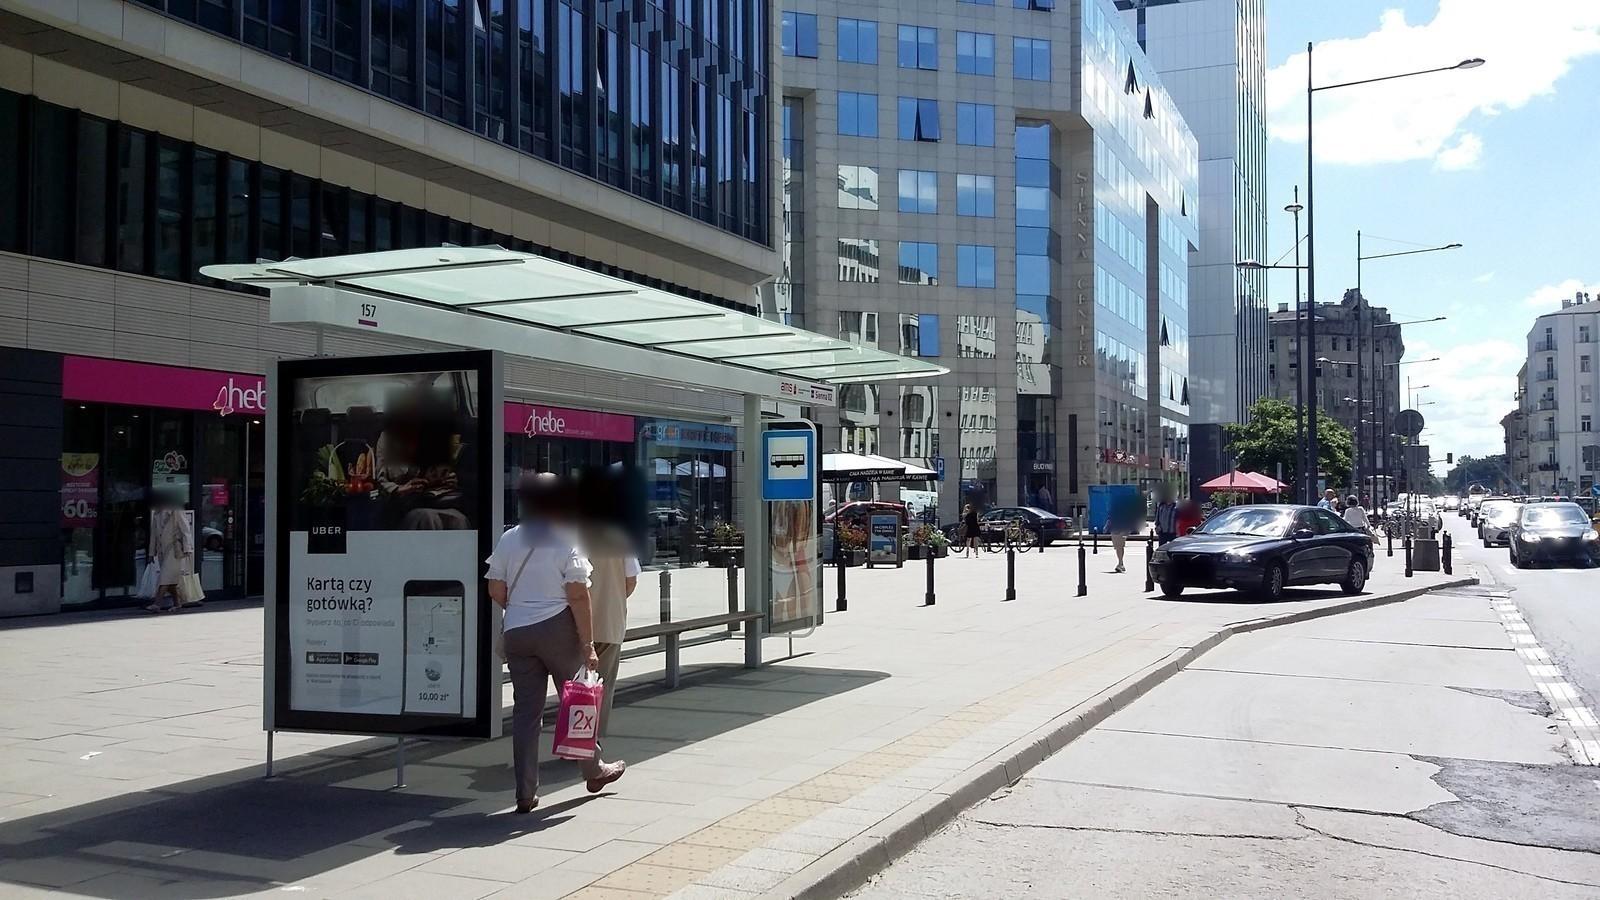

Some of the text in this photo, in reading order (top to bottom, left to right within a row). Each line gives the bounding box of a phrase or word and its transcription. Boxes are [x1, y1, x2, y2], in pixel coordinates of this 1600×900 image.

[1077, 172, 1088, 366] SIENNA CENTER
[361, 304, 376, 317] 157
[781, 382, 792, 392] ams
[532, 409, 565, 433] hebe
[312, 526, 342, 535] UBER
[307, 577, 372, 593] Kartą czy
[306, 596, 373, 613] gotówką?
[419, 692, 439, 701] 10,00
[572, 709, 594, 730] 2x
